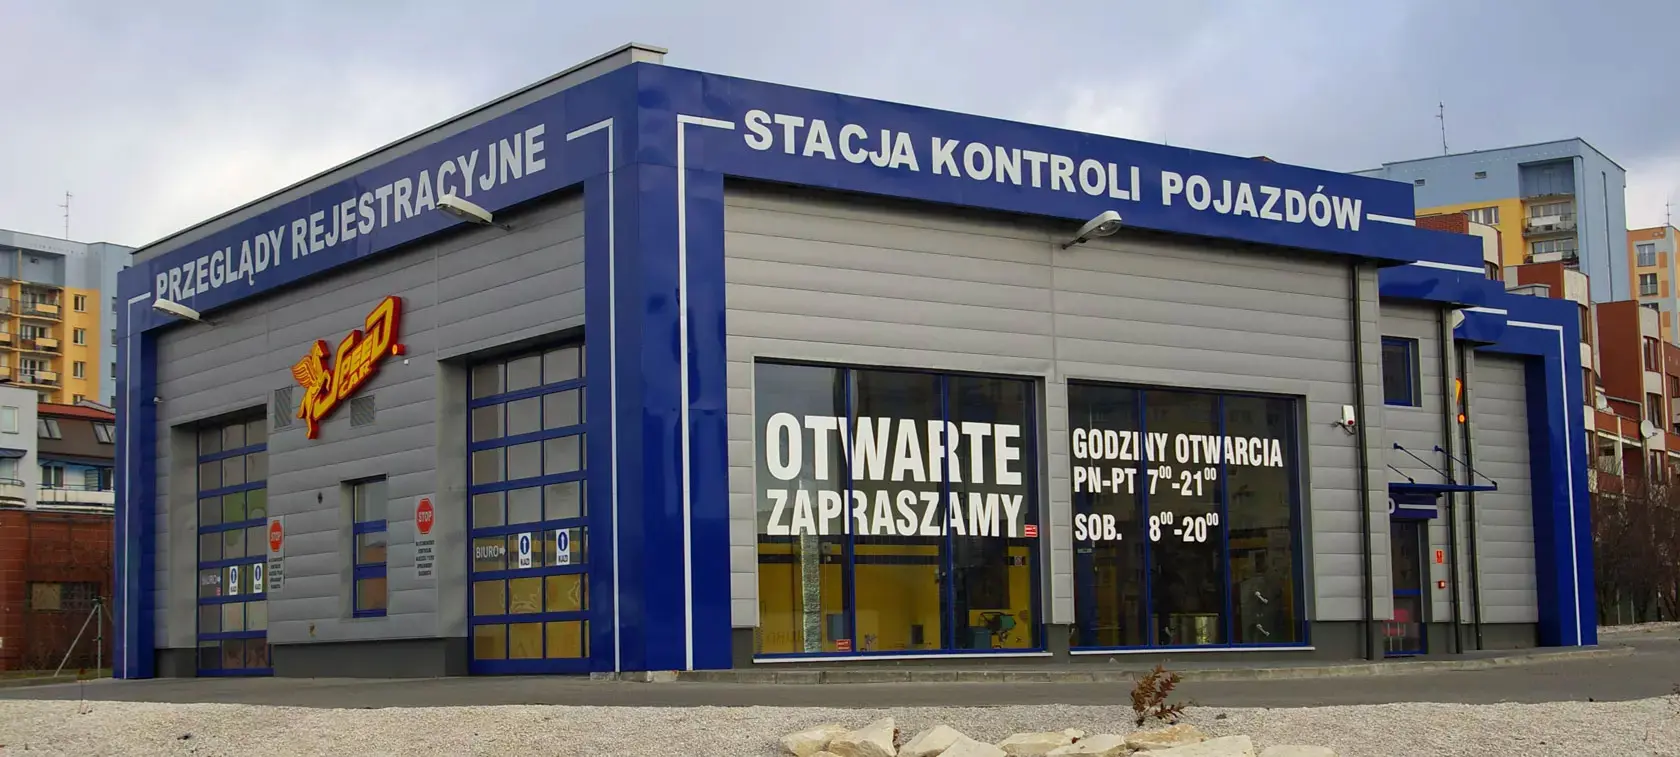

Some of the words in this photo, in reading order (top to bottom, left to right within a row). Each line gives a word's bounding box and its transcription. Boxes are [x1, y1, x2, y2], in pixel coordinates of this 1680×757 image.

[744, 110, 920, 172] STACJA
[932, 137, 1140, 202] KONTROLI
[1161, 170, 1362, 232] POJAZDÓW
[156, 225, 286, 301] PRZEGLĄDY
[292, 124, 546, 260] REJESTRACYJNE
[338, 361, 372, 399] CAR
[766, 412, 1022, 486] OTWARTE
[1073, 428, 1168, 462] GODZINY
[1175, 433, 1284, 468] OTWARCIA
[1073, 466, 1137, 494] PN-PT
[418, 510, 432, 523] STOP
[767, 489, 1023, 538] ZAPRASZAMY
[1075, 513, 1122, 541] SOB.
[475, 545, 499, 558] BIURO
